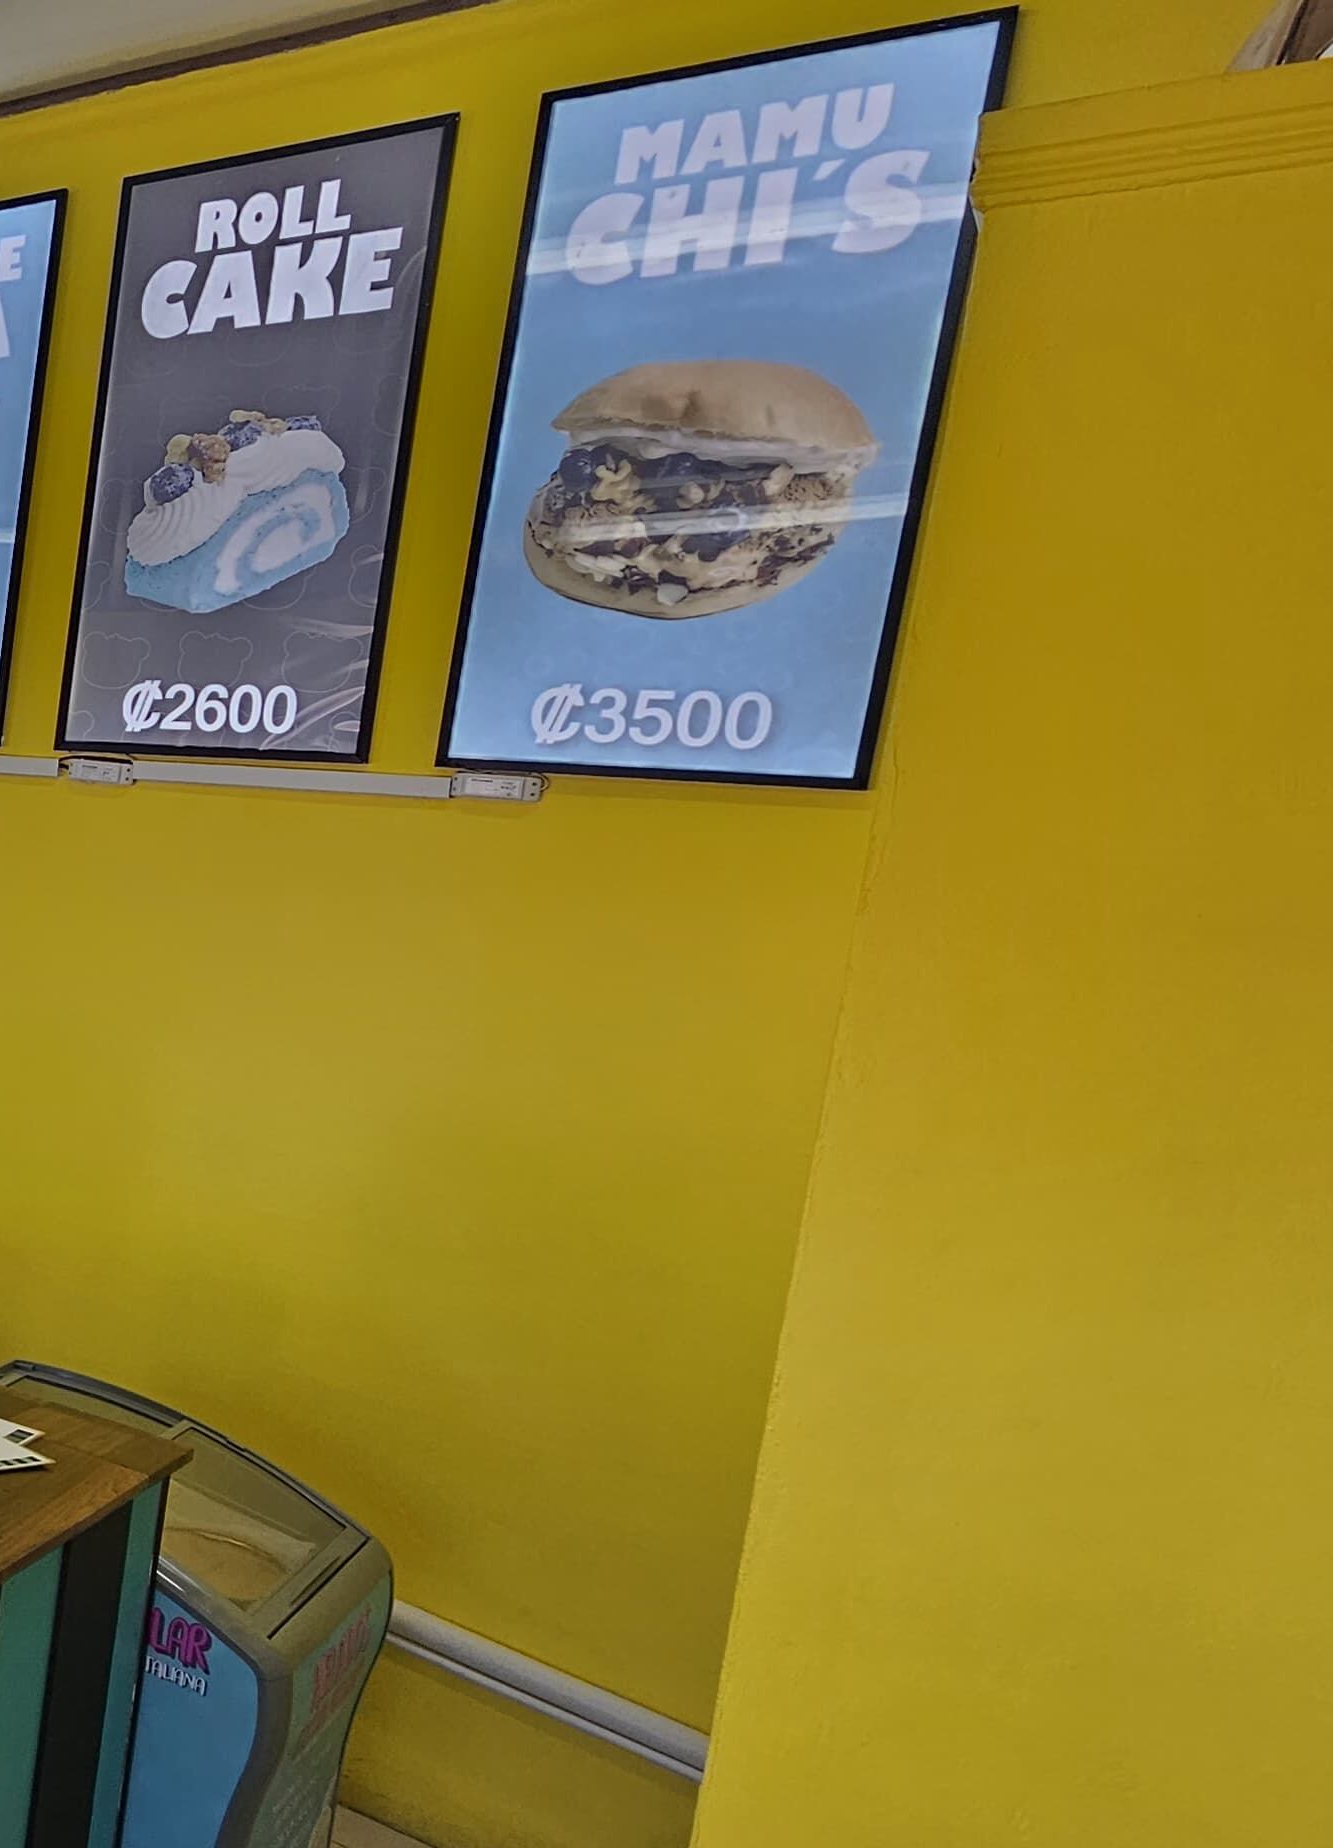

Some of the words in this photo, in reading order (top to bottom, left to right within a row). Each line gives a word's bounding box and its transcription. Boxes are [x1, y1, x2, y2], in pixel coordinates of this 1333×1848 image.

[614, 82, 894, 186] MAMU
[194, 178, 352, 253] ROLL
[141, 226, 403, 339] CAKE
